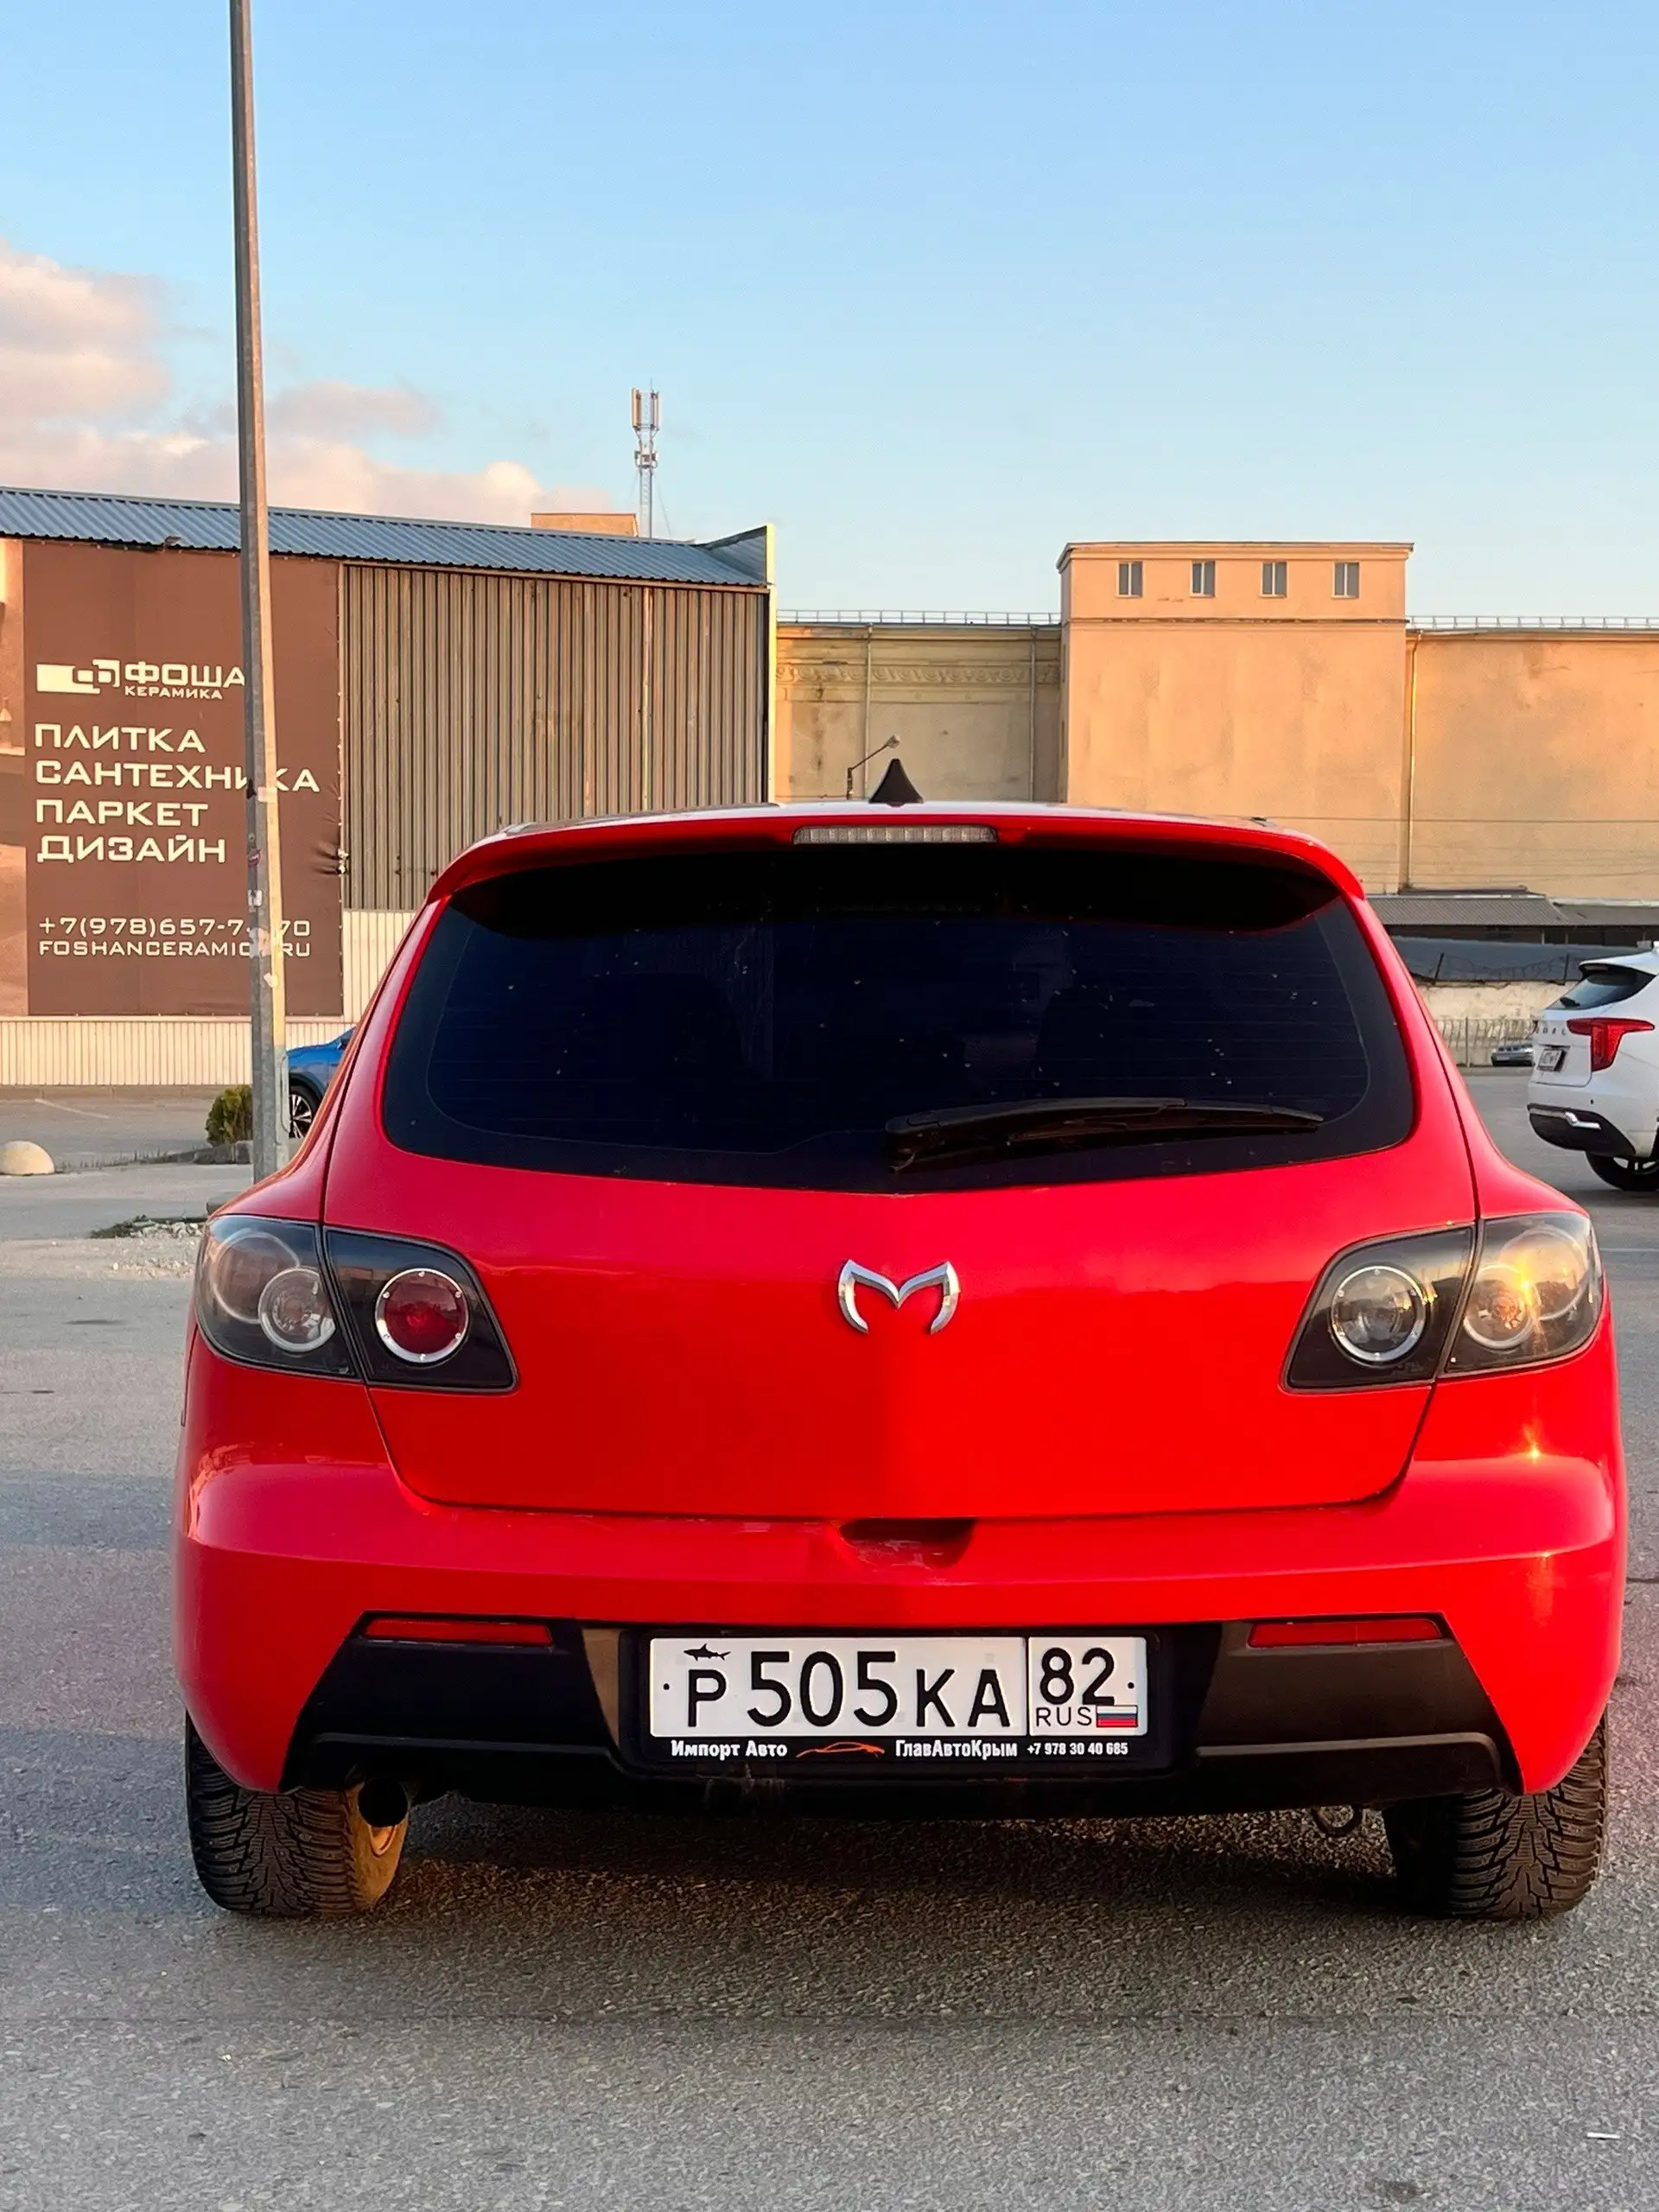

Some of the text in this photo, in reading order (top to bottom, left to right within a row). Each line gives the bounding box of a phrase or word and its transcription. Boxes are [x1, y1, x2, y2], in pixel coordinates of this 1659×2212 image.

[124, 685, 223, 701] КЕРАМИКА
[35, 723, 206, 753] ПЛИТКА
[36, 798, 209, 827] ПАРКЕТ
[36, 833, 226, 864] ДИЗАЙН
[39, 917, 310, 939] +7(978)657-770
[39, 940, 310, 957] FOSHANCERAMICRU
[1039, 1647, 1115, 1707] 82
[1035, 1706, 1092, 1727] RUS
[671, 1739, 741, 1761] Импорт
[745, 1739, 788, 1758] Авто
[895, 1739, 1018, 1761] ГлавАвтоКрым
[1027, 1742, 1041, 1756] +7
[1044, 1742, 1066, 1756] 978
[1069, 1742, 1084, 1756] 30
[1087, 1742, 1103, 1756] 40
